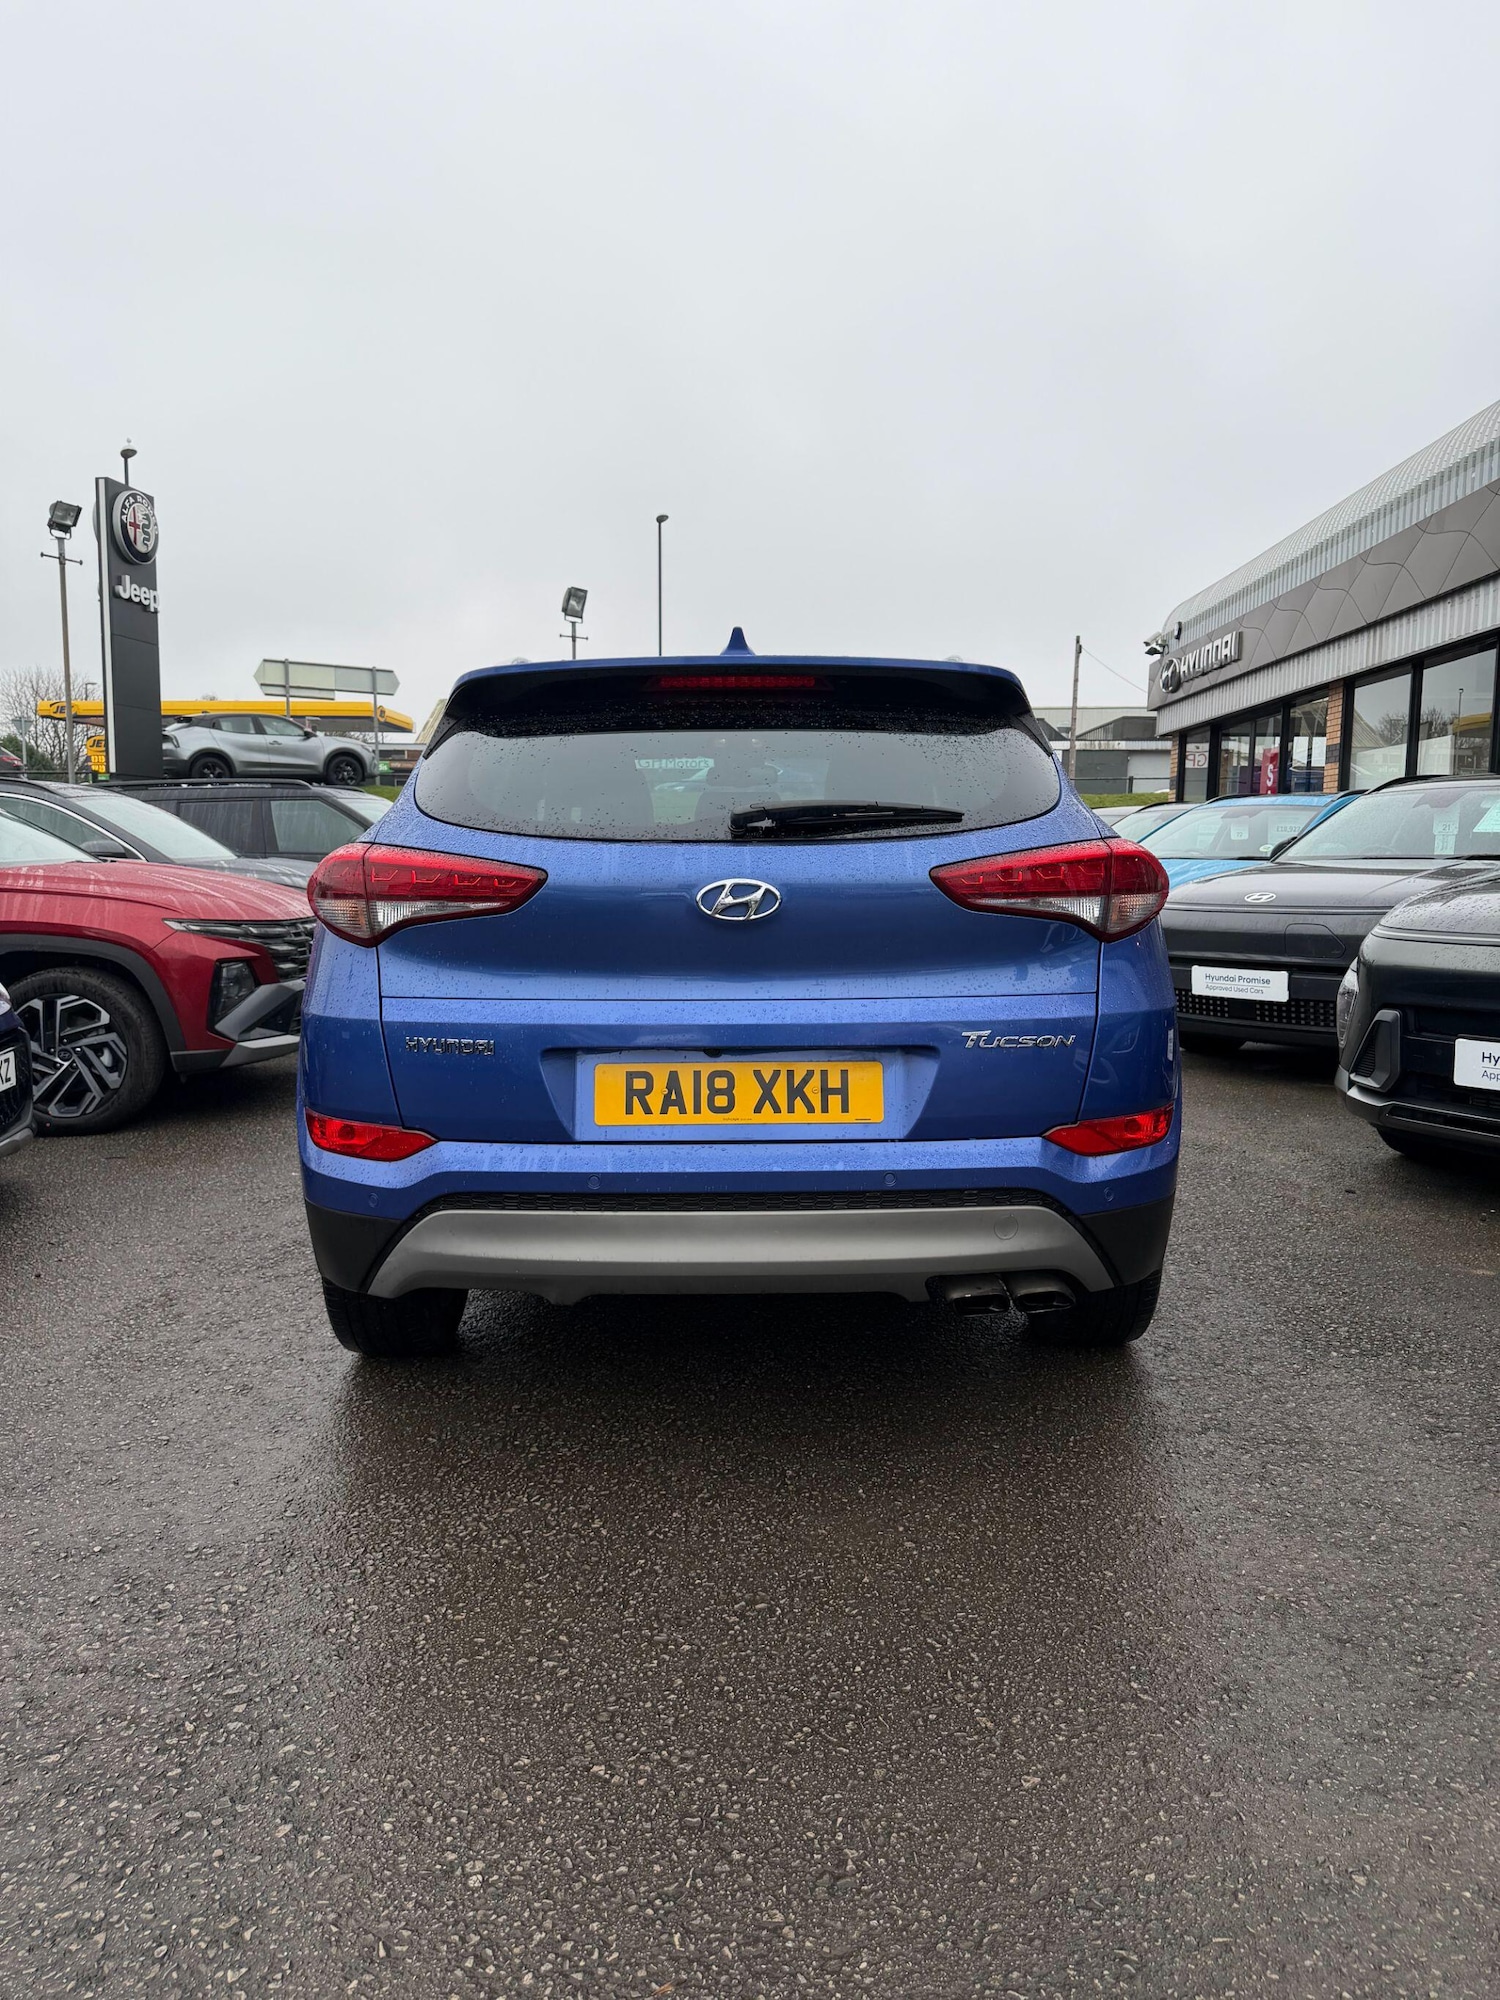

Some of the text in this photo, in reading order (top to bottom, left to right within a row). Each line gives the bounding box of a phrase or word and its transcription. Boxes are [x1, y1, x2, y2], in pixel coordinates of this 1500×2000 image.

[121, 496, 136, 523] ALFA
[115, 574, 160, 613] Jeep
[1181, 631, 1239, 682] HYUNDAI
[53, 703, 74, 714] JE
[89, 739, 105, 748] JE
[1205, 973, 1271, 985] Hyundai Promise
[1205, 984, 1233, 993] Approved
[405, 1036, 495, 1056] HYUNDAI
[625, 1069, 850, 1115] RA18 XKH
